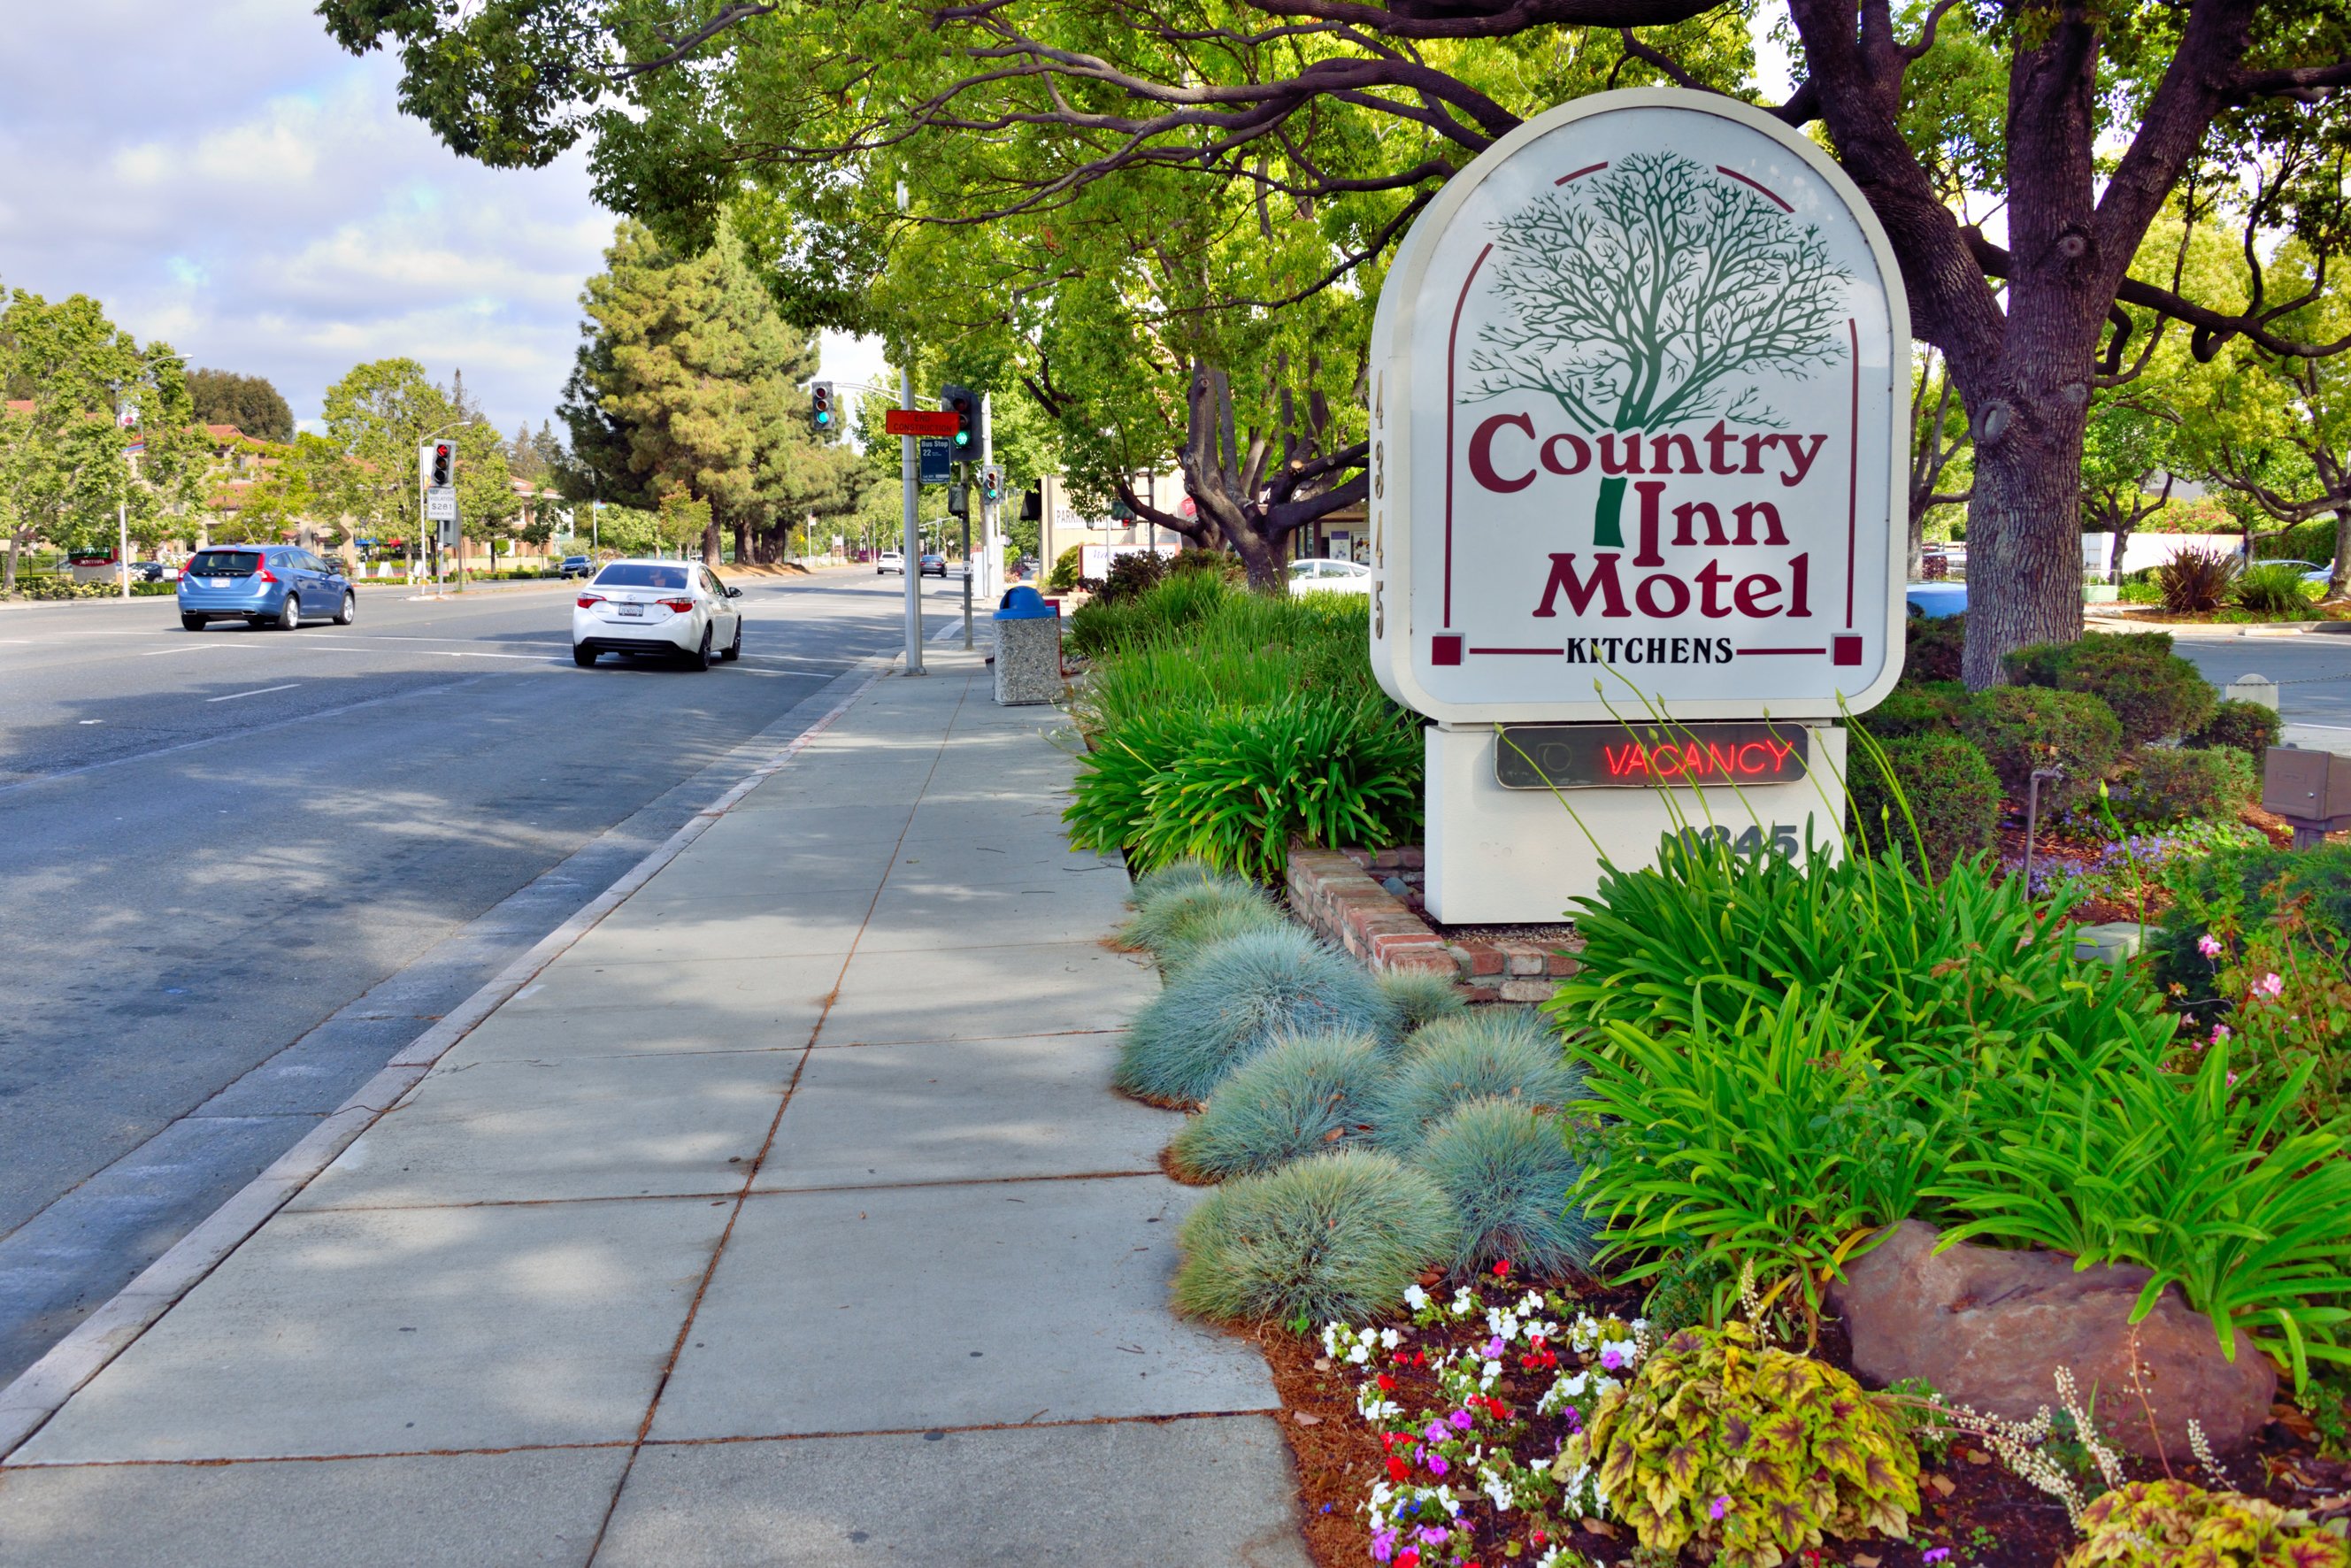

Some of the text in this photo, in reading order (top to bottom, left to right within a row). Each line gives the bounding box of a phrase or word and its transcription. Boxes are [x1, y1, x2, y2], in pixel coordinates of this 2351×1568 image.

[1468, 411, 1828, 493] Country
[1056, 510, 1085, 523] PARKIN
[1633, 481, 1790, 567] Inn
[1533, 552, 1812, 619] Motel
[1566, 637, 1733, 664] KITCHENS
[1604, 739, 1794, 776] VACANCY
